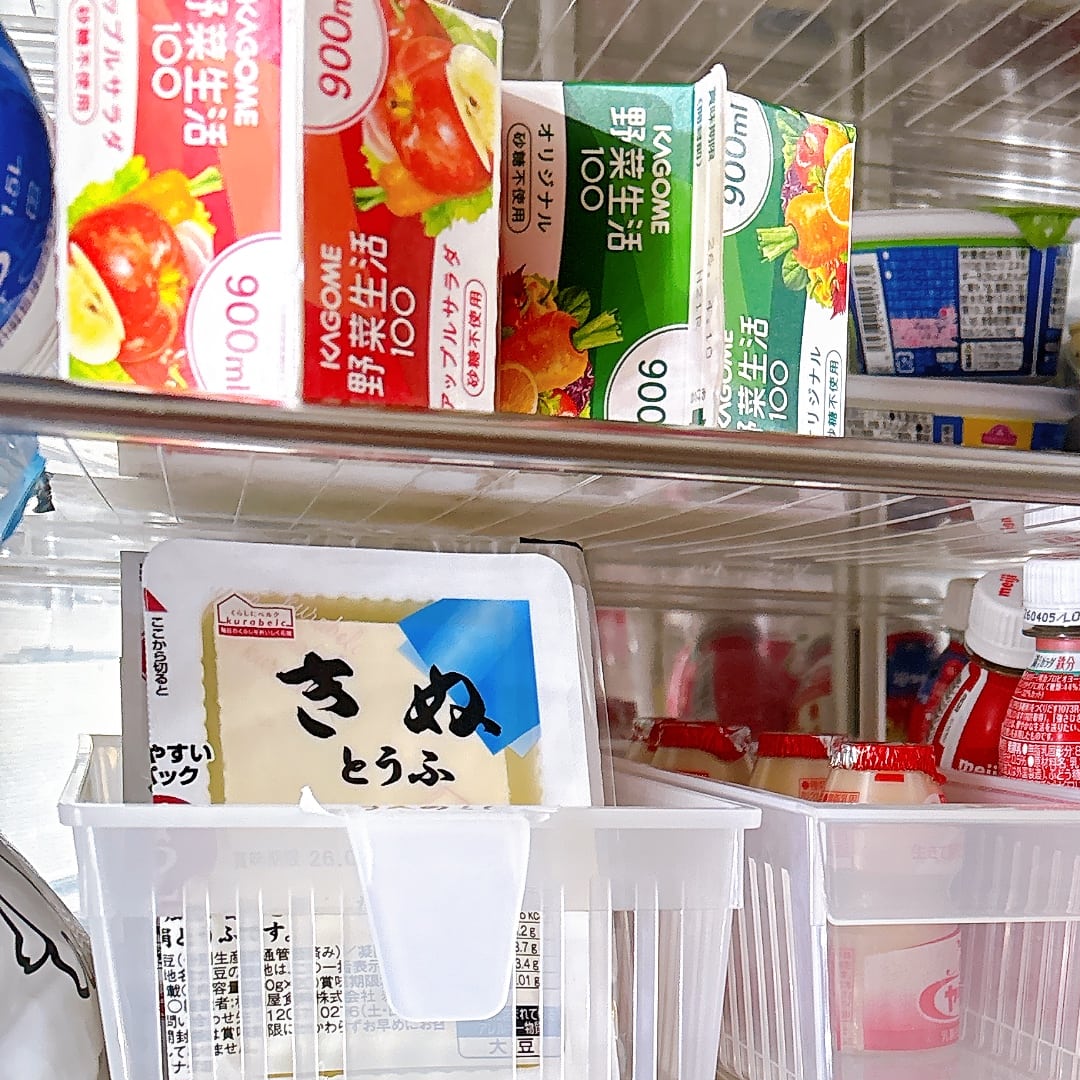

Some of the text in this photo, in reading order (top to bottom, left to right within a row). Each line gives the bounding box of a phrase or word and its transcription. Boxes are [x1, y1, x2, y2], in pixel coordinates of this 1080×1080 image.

[152, 22, 183, 100] 100
[511, 130, 527, 225] 砂糖不使用
[537, 124, 555, 233] オリジナル
[580, 147, 605, 212] 100
[607, 106, 648, 252] 野菜生活
[650, 124, 672, 235] KAGOME
[723, 103, 749, 206] 900ml
[319, 244, 344, 370] KAGOME
[346, 231, 389, 398] 野菜生活
[390, 285, 417, 359] 100
[438, 243, 462, 410] アップルサラダ
[466, 289, 485, 389] 砂糖不使用
[769, 360, 790, 421] 100
[806, 346, 822, 436] リジナル
[276, 651, 502, 739] きぬ
[149, 744, 213, 764] やすい
[341, 746, 456, 787] とうふ
